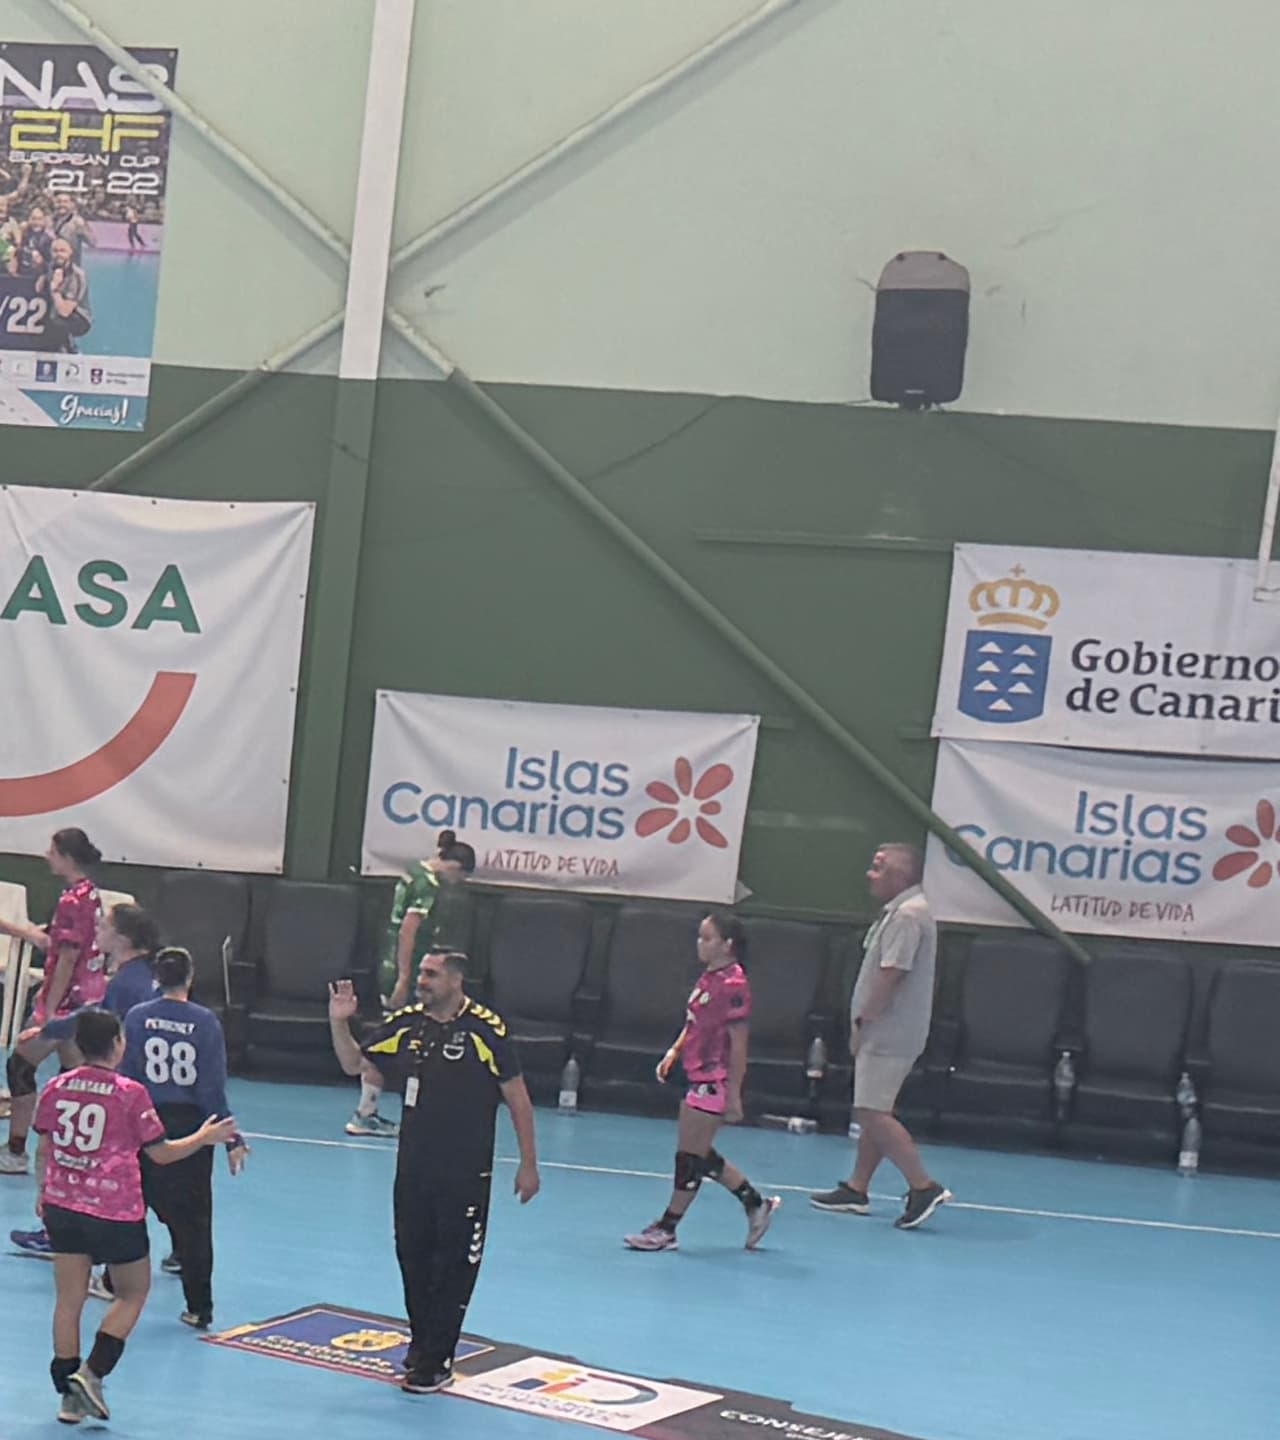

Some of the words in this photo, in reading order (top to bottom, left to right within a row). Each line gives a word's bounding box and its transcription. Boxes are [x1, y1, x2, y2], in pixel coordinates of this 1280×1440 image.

[10, 110, 165, 152] EHF
[47, 169, 160, 195] 21-22
[1071, 638, 1280, 683] Gobierno
[1066, 678, 1120, 714] de
[505, 747, 630, 797] Islas
[382, 781, 625, 840] Canarias
[1075, 791, 1207, 842] Islas
[484, 849, 552, 872] LATITUD
[557, 856, 577, 873] DE
[583, 857, 620, 877] VIDA
[945, 824, 1202, 885] Canarias
[1051, 894, 1122, 917] LATITUD
[1129, 900, 1151, 918] DE
[1155, 903, 1195, 922] VIDA
[144, 1036, 198, 1086] 88
[52, 1099, 107, 1153] 39
